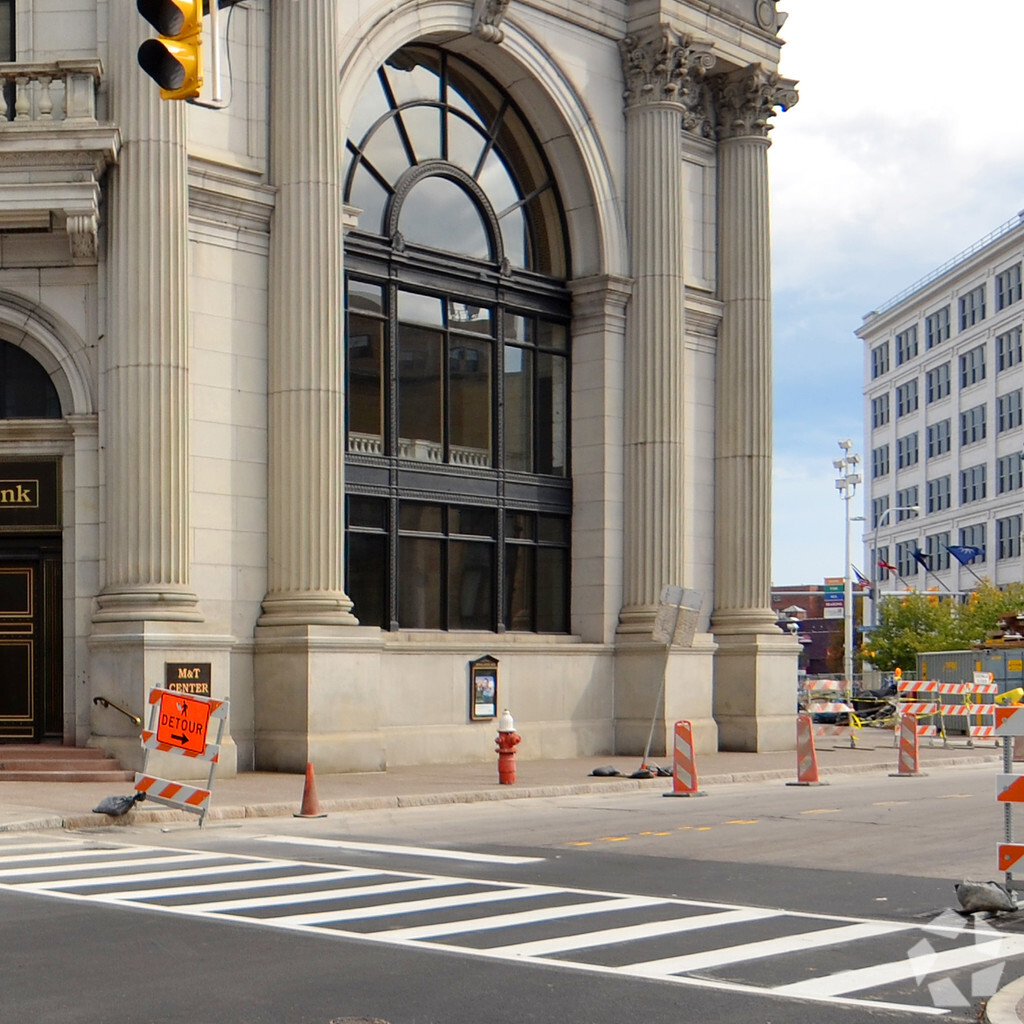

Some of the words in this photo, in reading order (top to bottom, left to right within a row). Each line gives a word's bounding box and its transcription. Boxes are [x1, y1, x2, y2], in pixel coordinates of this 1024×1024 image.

[177, 667, 201, 679] M&T
[168, 682, 209, 694] CENTER
[161, 714, 203, 735] DETOUR
